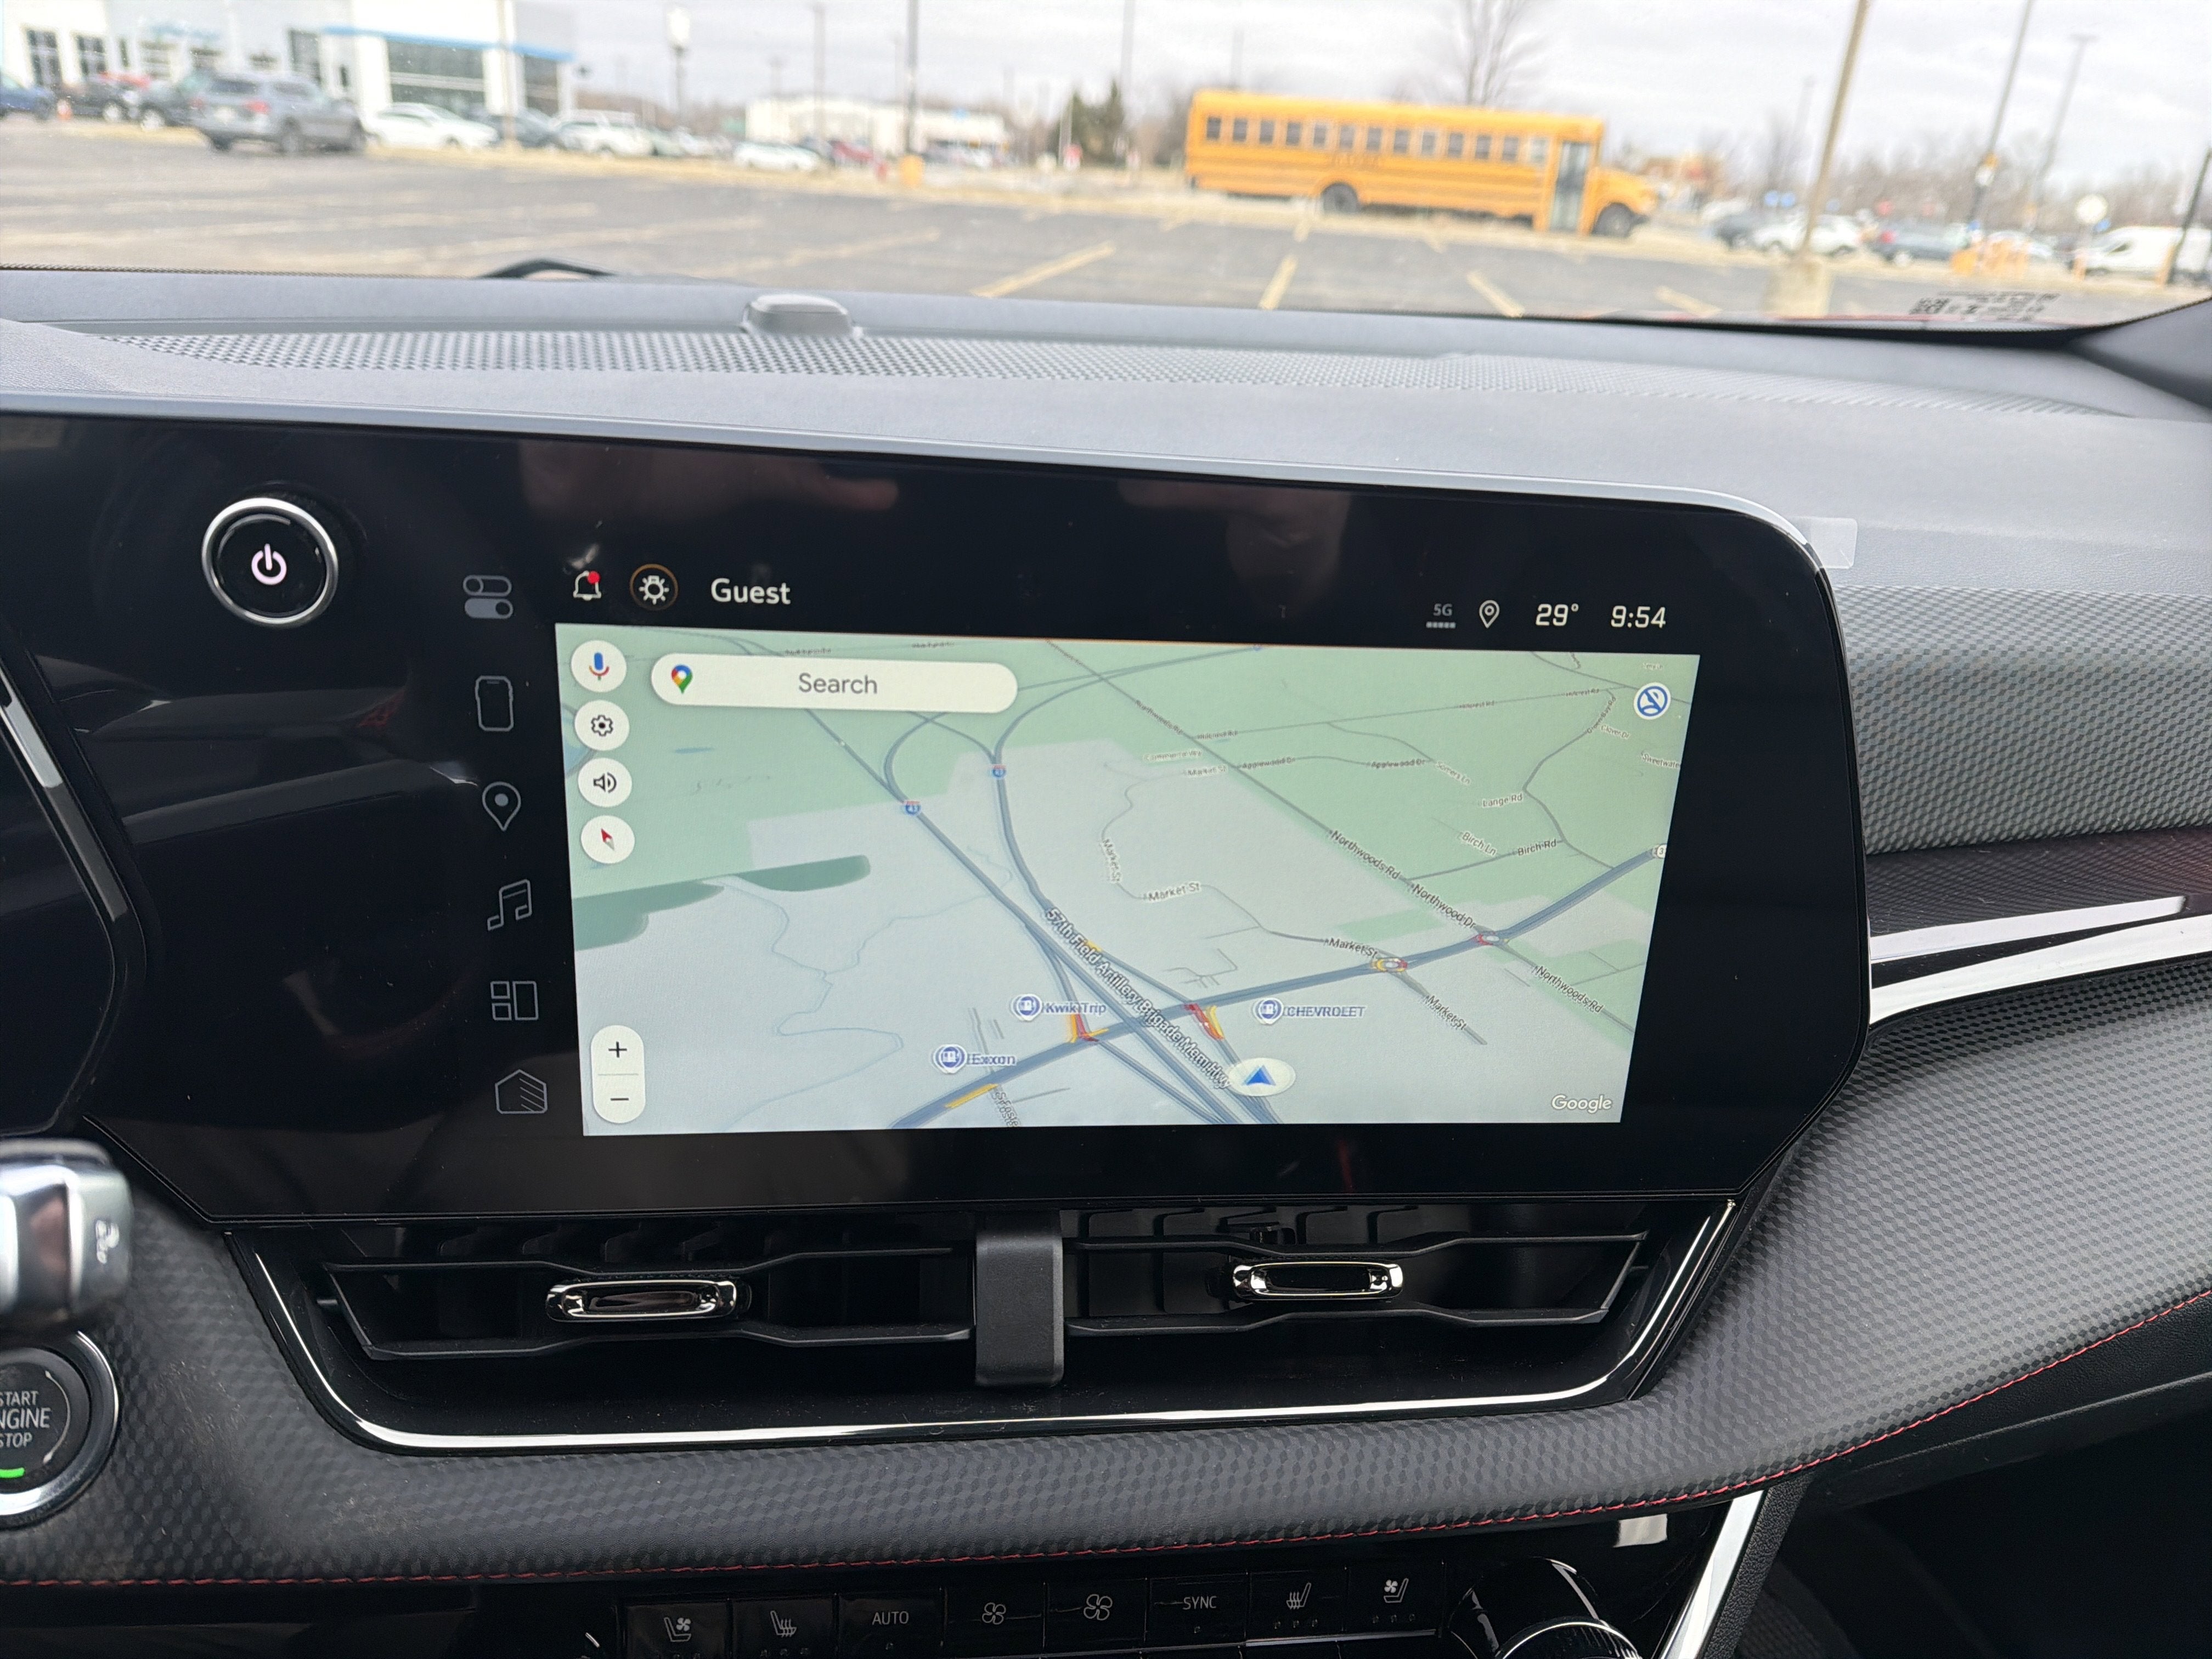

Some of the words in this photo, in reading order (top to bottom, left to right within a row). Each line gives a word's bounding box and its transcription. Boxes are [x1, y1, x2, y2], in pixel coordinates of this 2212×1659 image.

[711, 578, 791, 605] Guest
[1433, 603, 1453, 616] 5G
[1536, 603, 1579, 627] 29°
[1611, 605, 1666, 628] 9:54
[799, 673, 878, 694] Search
[1482, 795, 1509, 808] Lange
[1511, 793, 1523, 802] Rd
[1462, 832, 1485, 850] Birch
[1485, 844, 1497, 856] Ln
[1517, 843, 1542, 856] Birch
[1544, 839, 1557, 849] Rd
[1331, 830, 1385, 870] Northwoods
[1386, 865, 1401, 879] Rd
[1148, 885, 1187, 901] Market
[1188, 882, 1200, 891] St
[1413, 883, 1464, 923] Northwood
[1463, 916, 1475, 929] Dr
[1328, 938, 1365, 953] Market
[1366, 947, 1378, 958] St
[1046, 908, 1075, 938] 57th
[1071, 933, 1101, 963] Field
[1096, 960, 1142, 1006] Artillery
[1136, 999, 1182, 1045] Brigade
[1207, 1064, 1232, 1090] Hwy
[1536, 965, 1589, 1007] Northwoods
[1589, 1000, 1604, 1013] Rd
[1045, 1003, 1077, 1014] Kwik
[1081, 1003, 1107, 1015] Trip
[1287, 1006, 1365, 1017] CHEVROLET
[1427, 995, 1457, 1024] Market
[1455, 1018, 1467, 1031] St
[970, 1054, 1016, 1065] Exxon
[1551, 1094, 1612, 1114] Google
[1183, 1596, 1217, 1610] SYNC
[872, 1611, 910, 1626] AUTO
